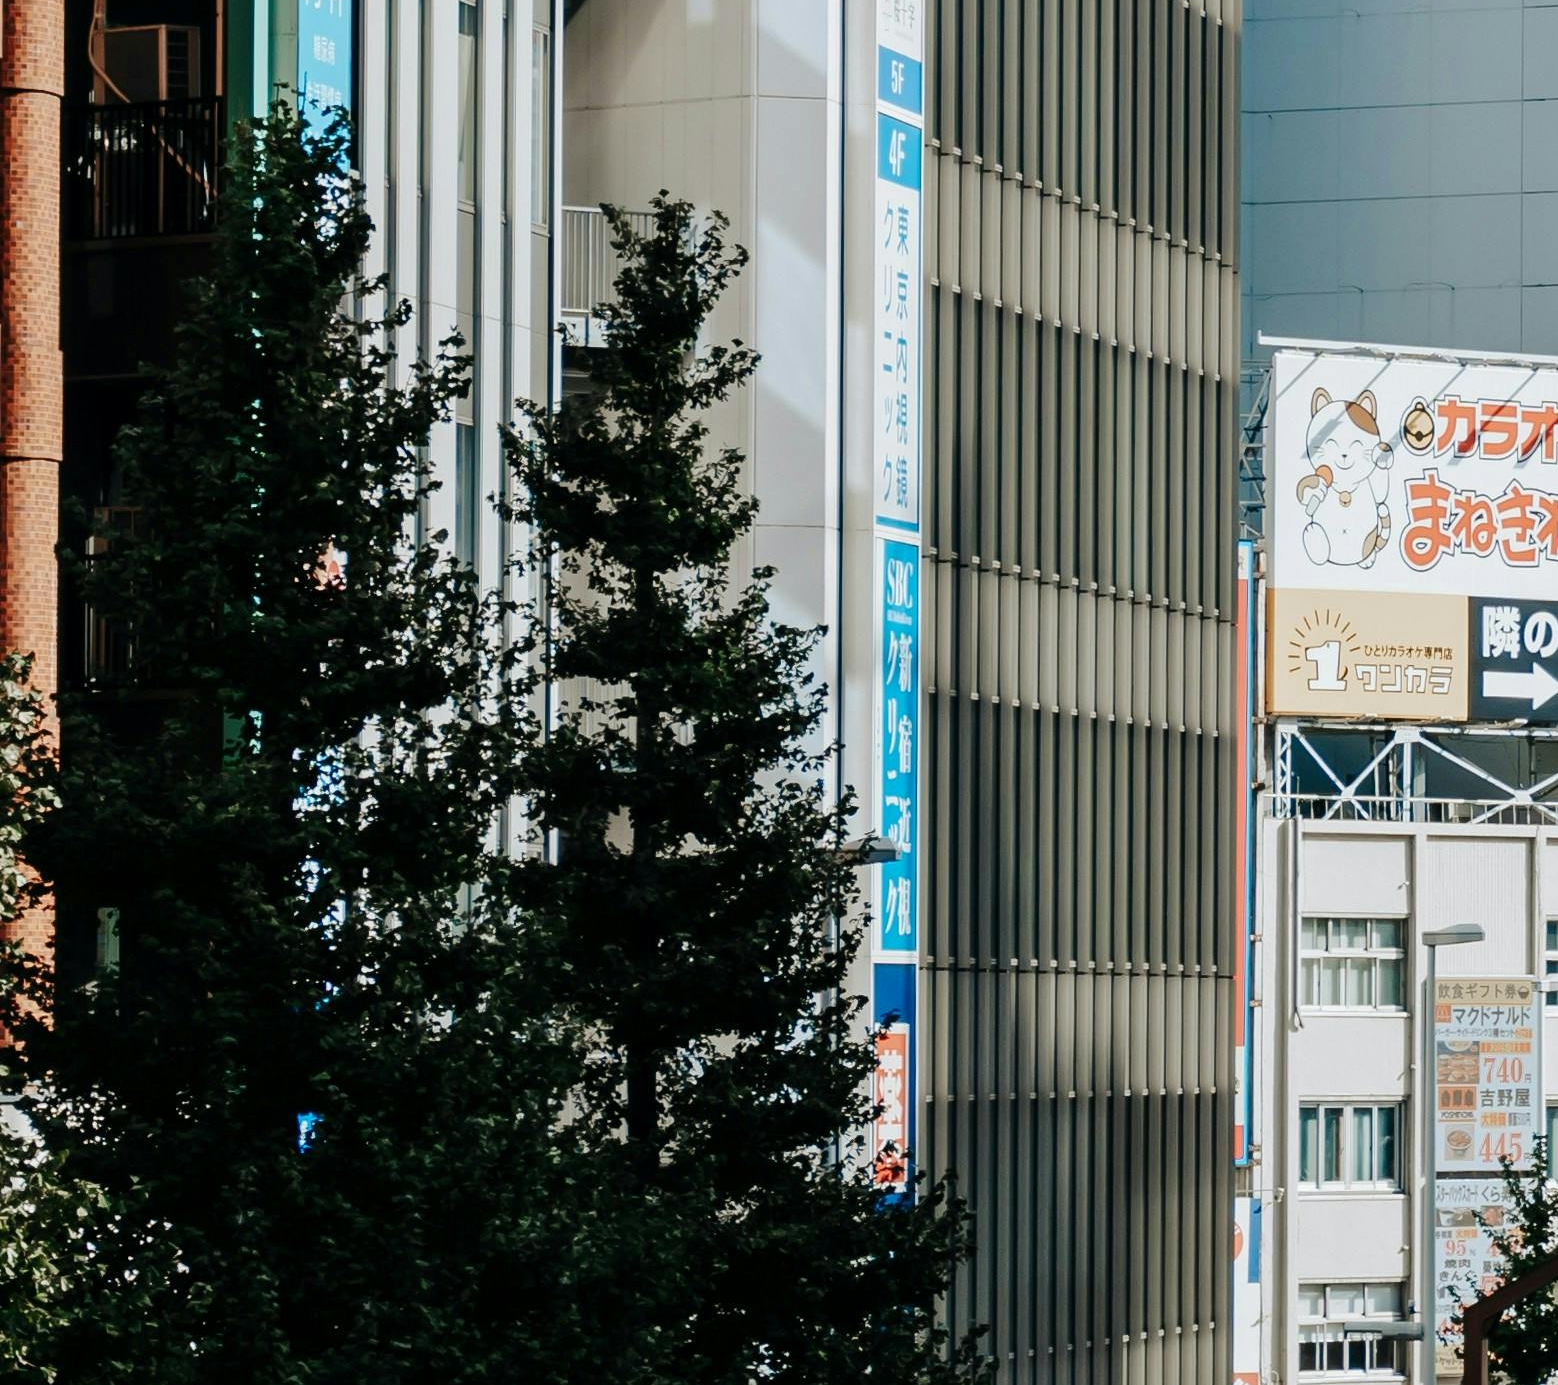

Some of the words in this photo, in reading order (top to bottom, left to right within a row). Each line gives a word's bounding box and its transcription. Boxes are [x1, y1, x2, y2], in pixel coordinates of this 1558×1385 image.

[890, 59, 906, 97] 5F
[888, 136, 907, 177] 4F
[881, 198, 895, 504] クリニック
[895, 205, 910, 511] 東京内視鏡
[885, 557, 914, 610] SBC
[1364, 643, 1453, 661] ひとりカラオケ専門店
[1355, 663, 1453, 694] ワンカラ
[1438, 982, 1517, 1000] 飲食ギフト券
[1453, 1006, 1532, 1026] マクドナルド
